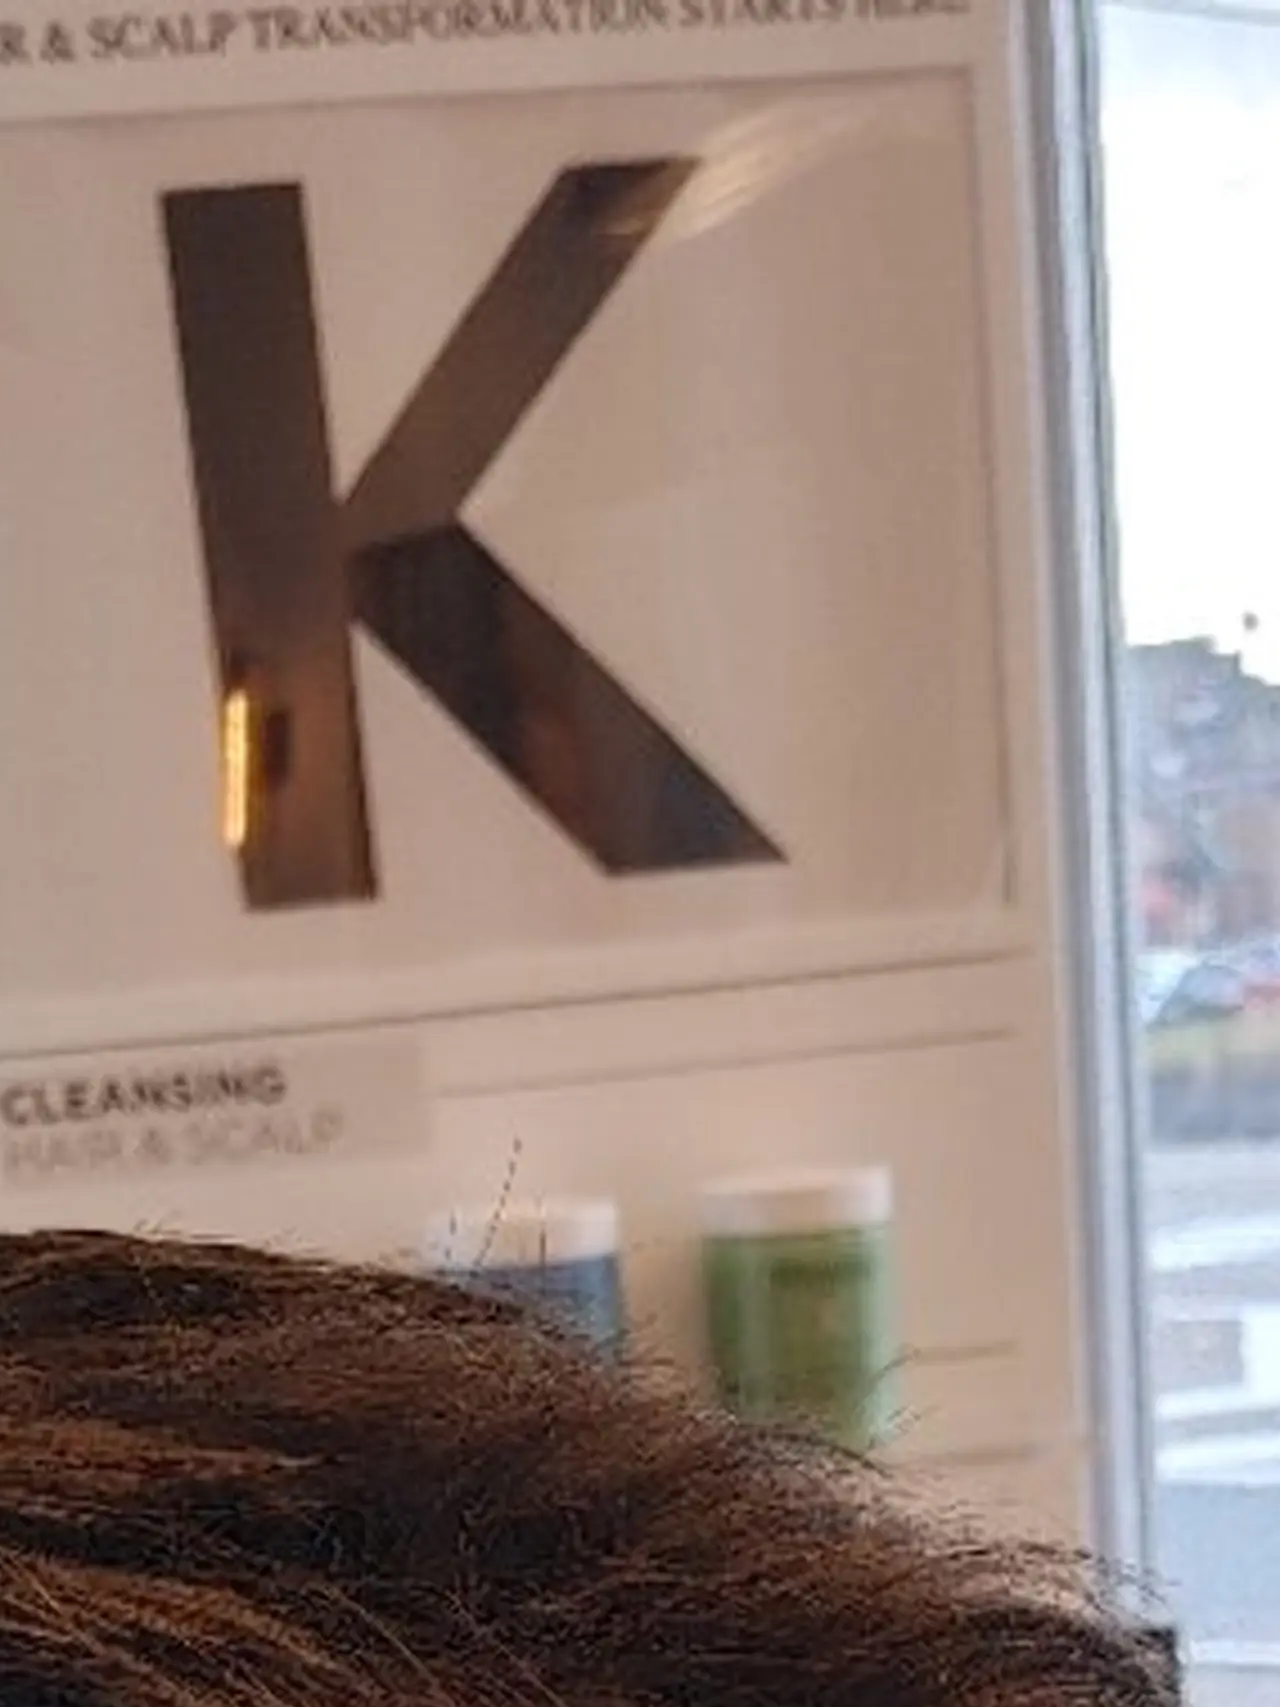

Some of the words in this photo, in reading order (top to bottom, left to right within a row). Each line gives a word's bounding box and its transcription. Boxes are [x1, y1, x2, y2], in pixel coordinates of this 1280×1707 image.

[40, 19, 77, 65] &
[87, 9, 237, 61] SCALP
[246, 0, 670, 53] TRANSFORMATION
[158, 156, 790, 912] K
